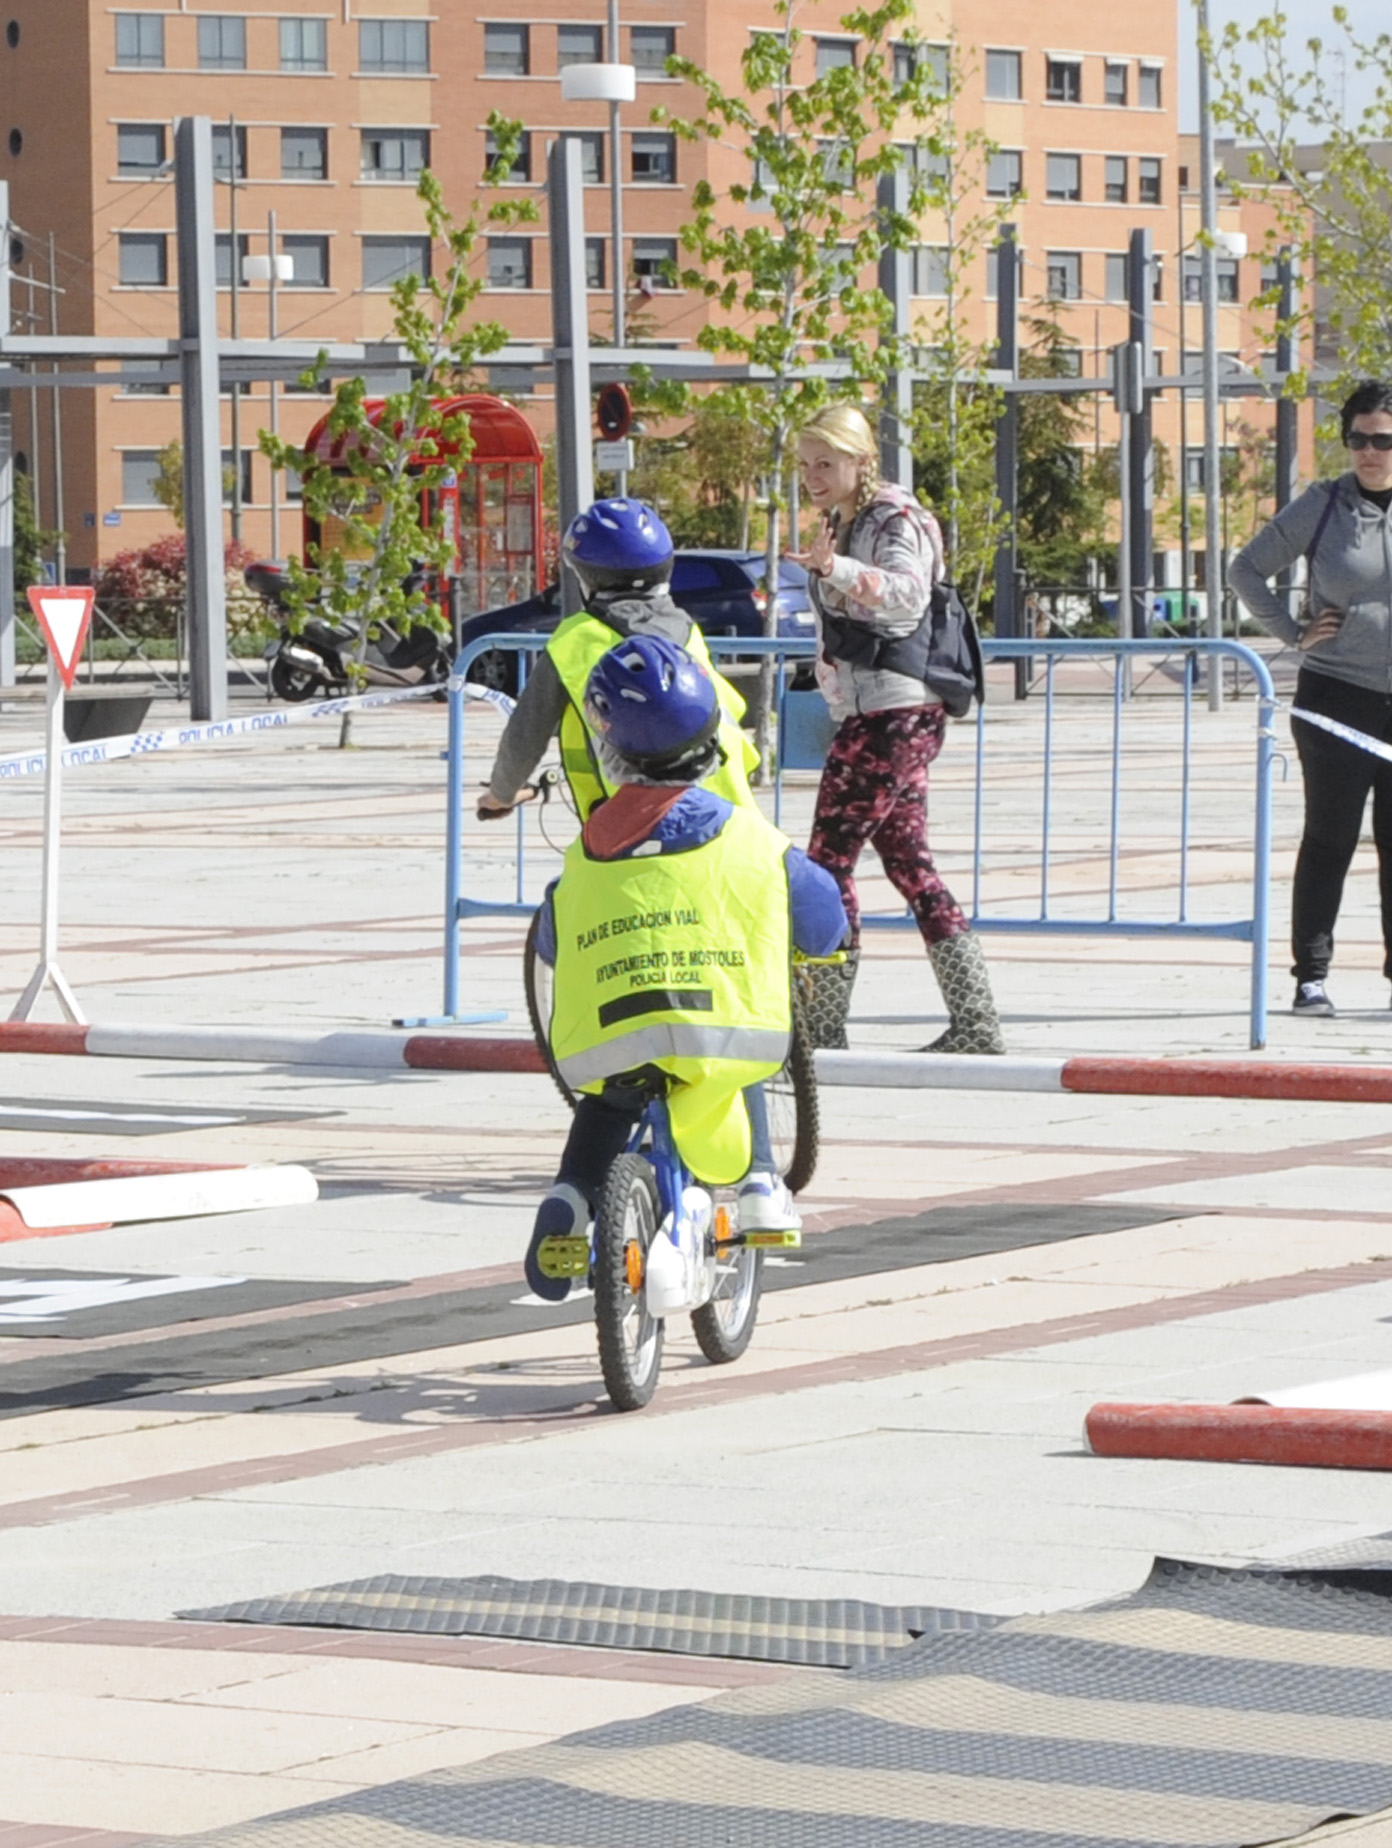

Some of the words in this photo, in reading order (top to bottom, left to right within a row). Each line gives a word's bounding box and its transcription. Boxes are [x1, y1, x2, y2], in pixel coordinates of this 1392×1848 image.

[576, 929, 598, 952] PLAN
[598, 921, 610, 941] DE
[674, 908, 700, 926] VIAL
[671, 951, 687, 967] DE
[669, 971, 702, 984] LOCAL
